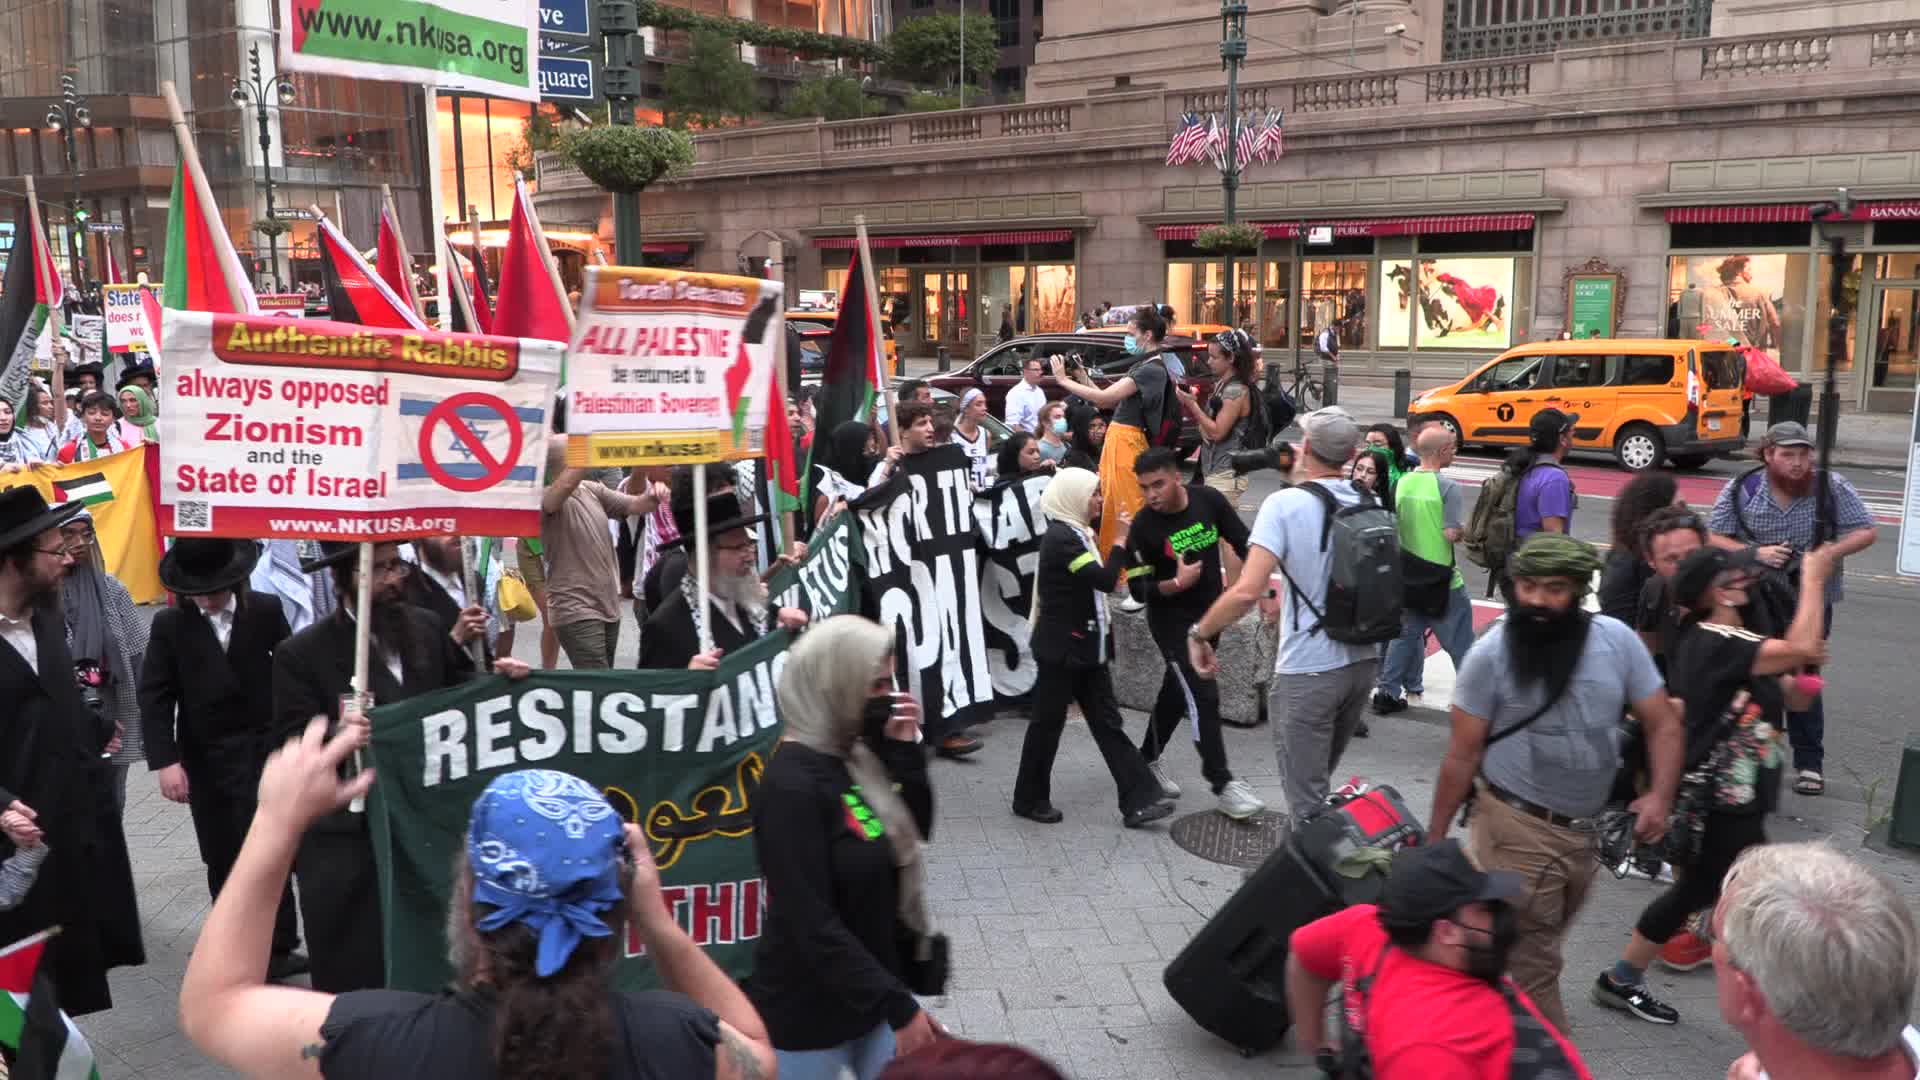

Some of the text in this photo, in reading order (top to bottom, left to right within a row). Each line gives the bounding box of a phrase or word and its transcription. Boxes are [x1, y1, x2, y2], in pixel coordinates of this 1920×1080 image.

[540, 8, 564, 25] ve
[297, 7, 524, 73] www.nkusa.org
[537, 70, 588, 91] quare
[226, 321, 508, 370] Authentic Rabbis
[576, 325, 628, 354] ALL
[176, 368, 389, 409] always opposed
[204, 413, 363, 447] Zionism
[246, 449, 323, 465] and the
[176, 464, 388, 498] State of Israel
[269, 515, 457, 535] www.NKUSA.org
